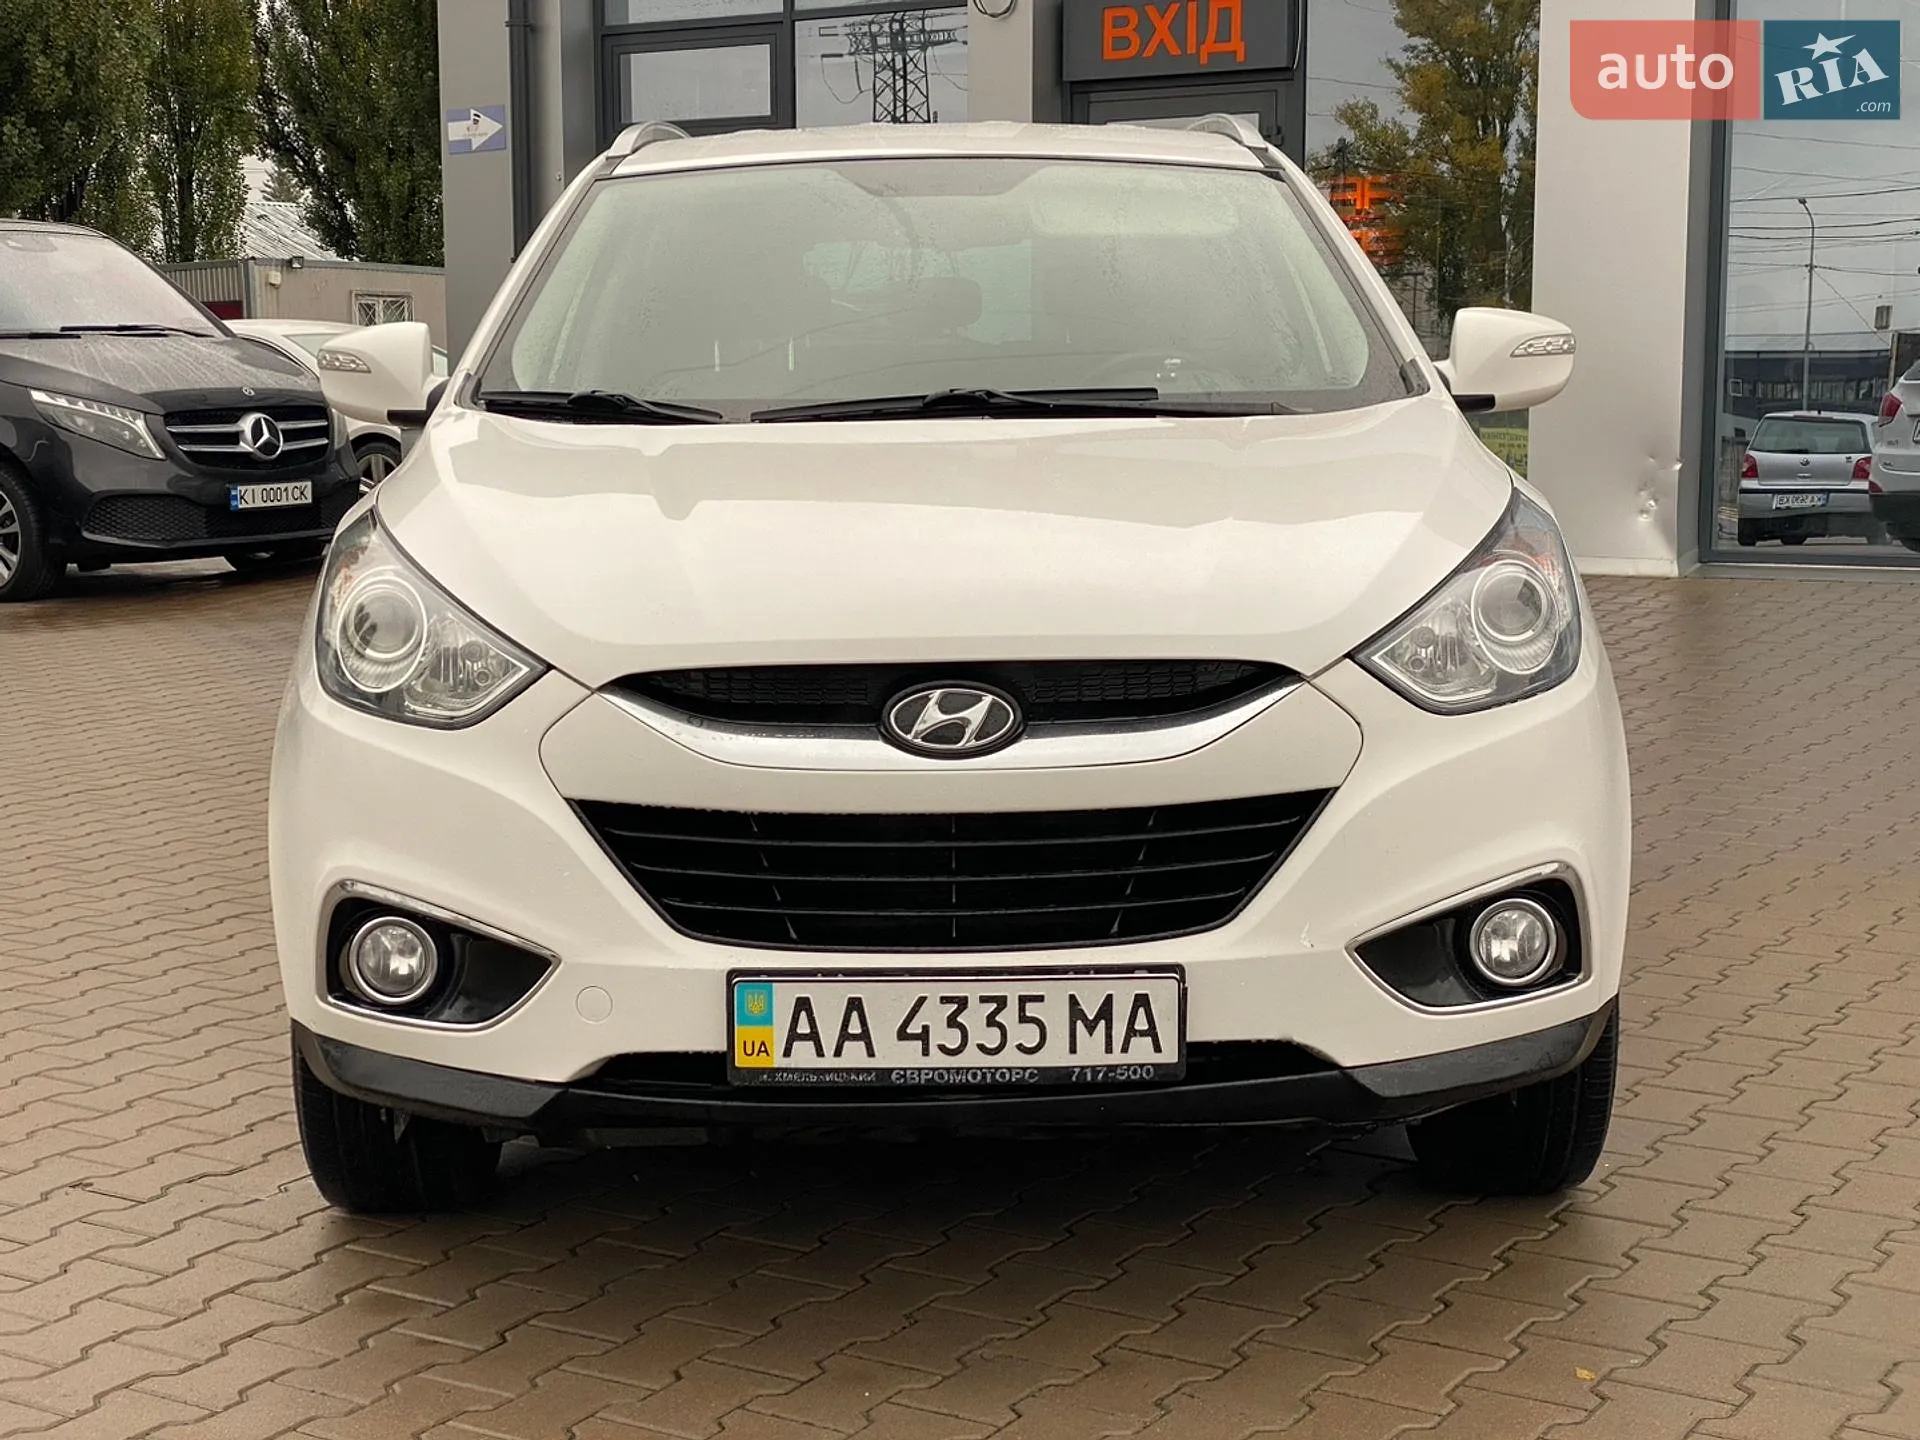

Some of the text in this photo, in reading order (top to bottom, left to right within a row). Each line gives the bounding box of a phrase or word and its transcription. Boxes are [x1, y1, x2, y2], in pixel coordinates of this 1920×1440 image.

[1102, 0, 1246, 65] ВХІД
[239, 485, 308, 504] KI 0001 CK
[782, 992, 1164, 1059] AA 4335 MA
[743, 1040, 770, 1057] UA
[890, 1067, 1040, 1086] ЄВРОМОТОРС
[1070, 1064, 1155, 1082] 717-500
